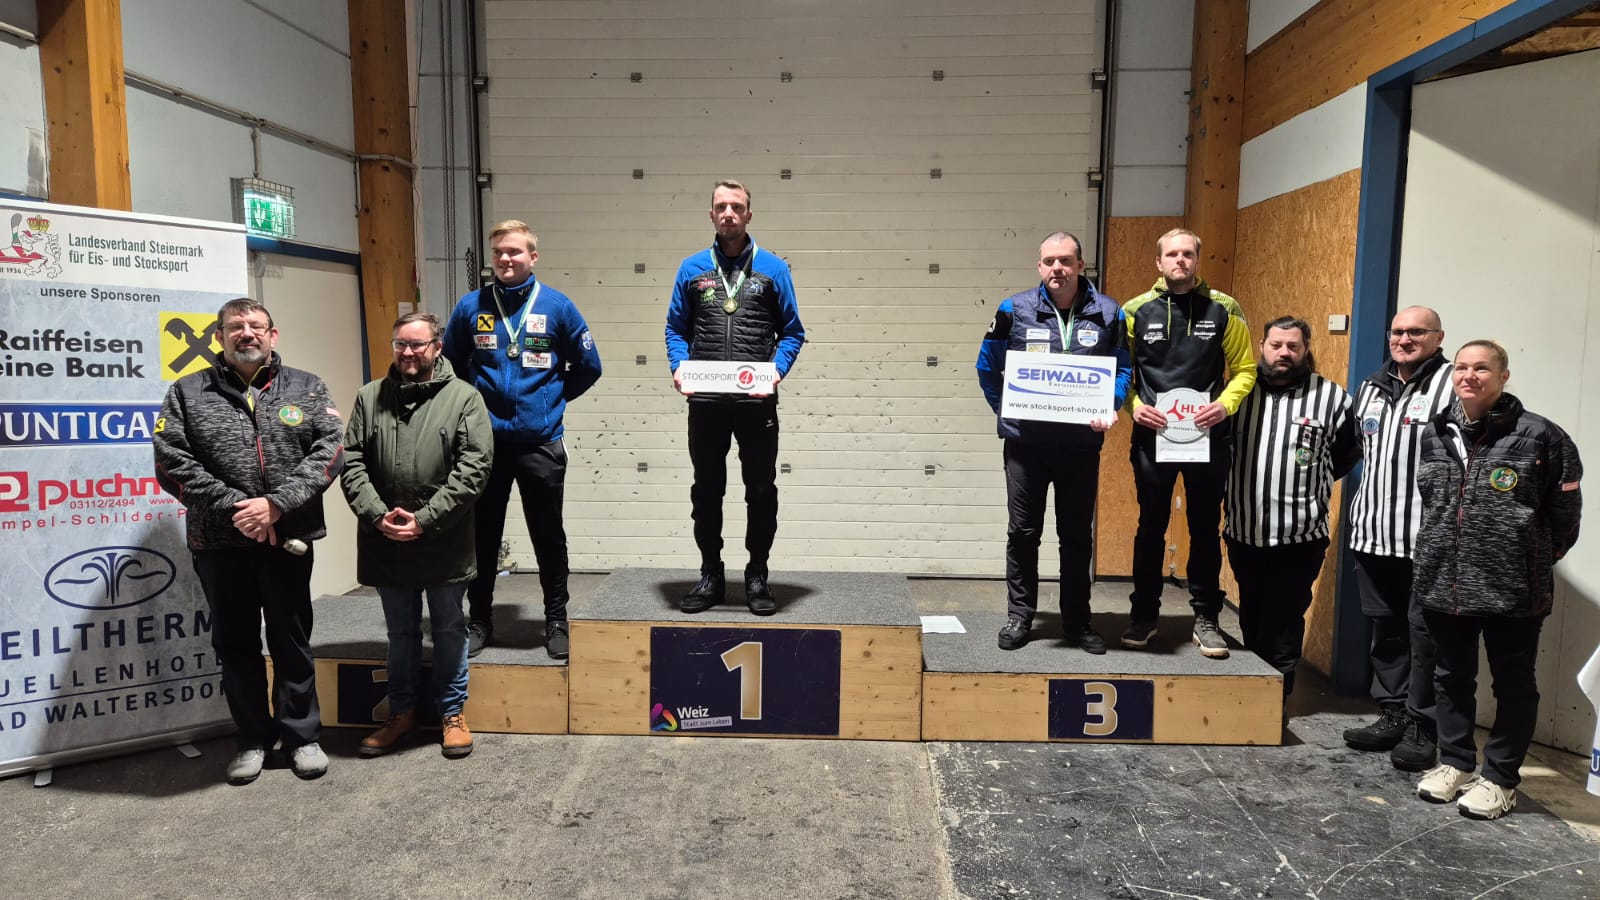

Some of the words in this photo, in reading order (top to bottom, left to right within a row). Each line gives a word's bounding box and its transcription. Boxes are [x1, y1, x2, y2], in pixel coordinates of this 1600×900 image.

[68, 233, 146, 253] Landesverband
[149, 240, 204, 258] Steiermark
[69, 250, 84, 264] für
[88, 252, 109, 266] Eis-
[112, 254, 131, 268] und
[134, 256, 189, 274] Stocksport
[40, 287, 87, 299] unsere
[90, 288, 161, 303] Sponsoren
[0, 355, 54, 378] ine
[66, 357, 145, 379] Bank
[1017, 367, 1101, 385] SEIWALD
[682, 372, 738, 382] STOCKSPORT
[739, 371, 753, 384] 4
[755, 374, 773, 383] YOU
[1008, 401, 1108, 416] www.stocksport-shop.at
[0, 411, 160, 442] UNTIGA
[69, 498, 136, 510] 03112/2494
[149, 497, 181, 506] www.
[720, 641, 763, 720] 1
[676, 705, 710, 719] Weiz
[1083, 681, 1118, 736] 3
[0, 710, 27, 732] D
[713, 718, 730, 726] Leben
